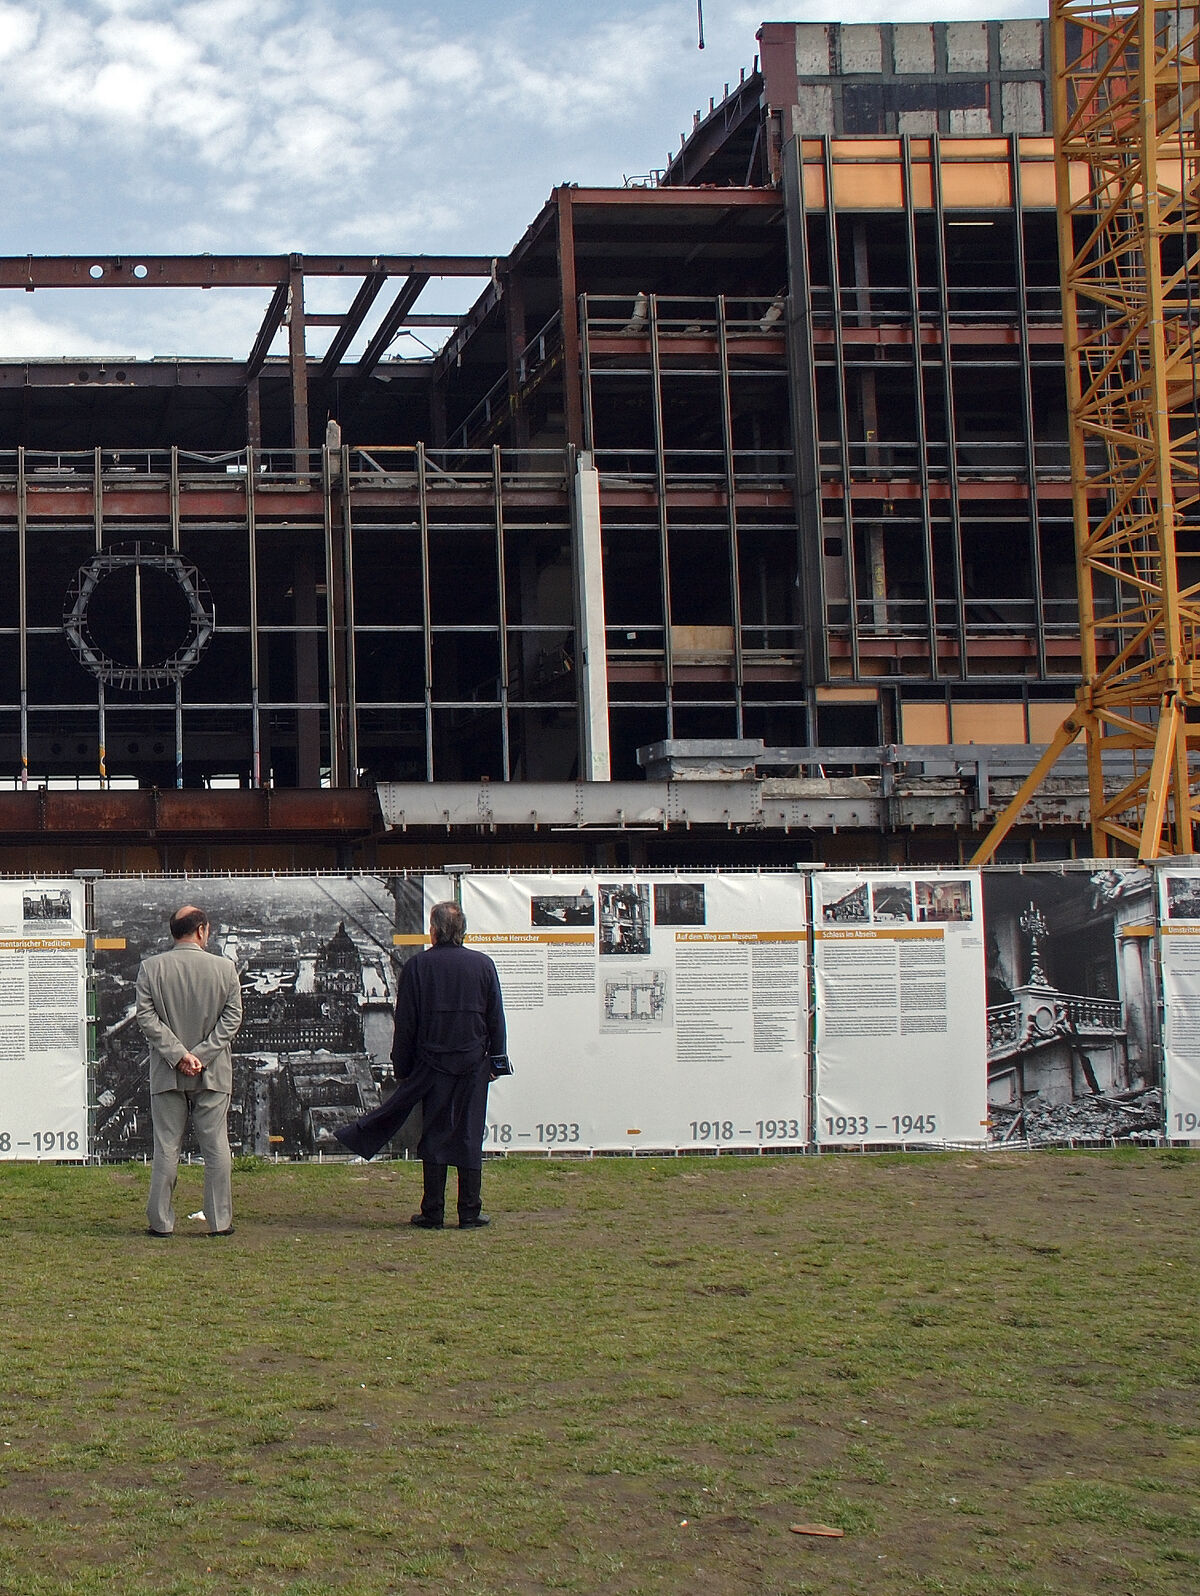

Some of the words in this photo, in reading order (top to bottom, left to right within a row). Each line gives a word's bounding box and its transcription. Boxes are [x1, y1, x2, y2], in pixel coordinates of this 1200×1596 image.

[41, 939, 71, 947] Tradition
[467, 934, 491, 942] Schloss
[491, 934, 509, 942] ohne
[509, 934, 540, 942] Herrscher
[703, 933, 717, 942] Weg
[731, 932, 758, 940] Museum
[855, 930, 877, 938] Abseits
[689, 1120, 734, 1141] 1918
[755, 1119, 799, 1140] 1933
[825, 1115, 869, 1136] 1933
[891, 1114, 936, 1135] 1945
[1174, 1112, 1200, 1132] 19
[32, 1130, 79, 1152] 1918
[535, 1123, 580, 1143] 1933
